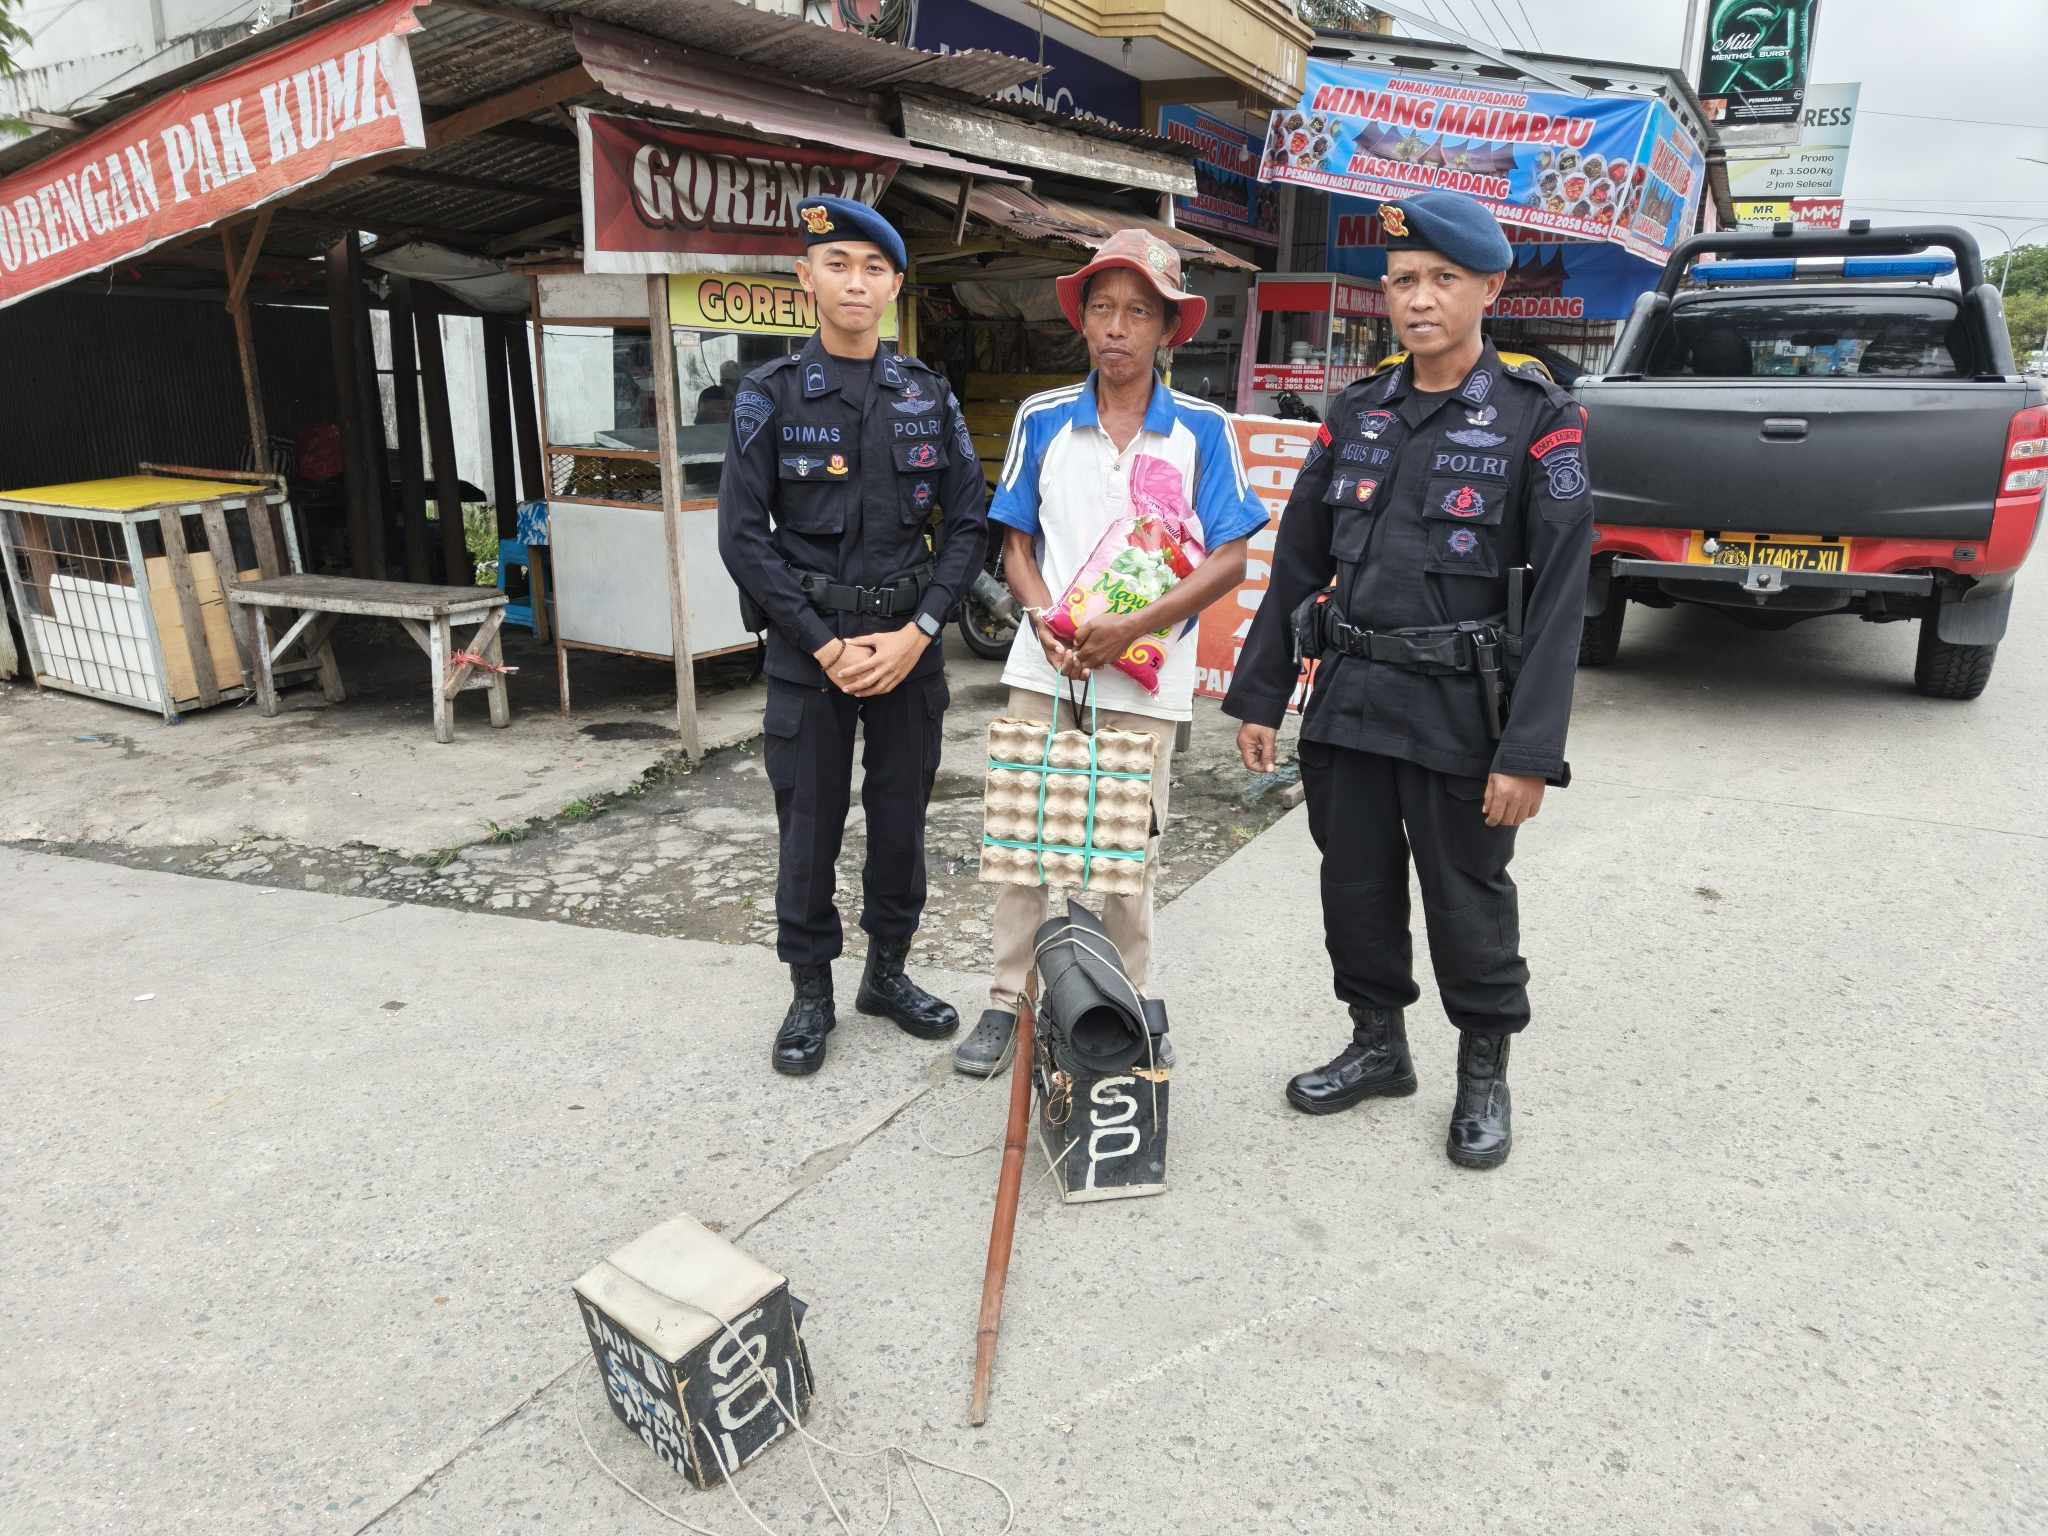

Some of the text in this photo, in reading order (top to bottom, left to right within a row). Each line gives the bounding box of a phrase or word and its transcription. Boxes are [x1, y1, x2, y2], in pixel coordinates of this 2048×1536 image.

[1712, 33, 1760, 51] Mild
[1711, 50, 1791, 61] MENTHOL BURST
[1388, 79, 1528, 109] RUMAH MAKAN PADANG
[1312, 84, 1597, 149] MINANG MAIMBAU
[1803, 107, 1852, 127] RESS
[1800, 154, 1834, 163] Promo
[0, 139, 160, 273] ORENGAN
[161, 99, 256, 203] PAK
[1328, 175, 1350, 188] NASI
[1348, 155, 1511, 199] MASAKAN PADANG
[1766, 181, 1773, 189] 2
[1753, 205, 1774, 214] MR
[1530, 211, 1554, 226] 0812
[1555, 215, 1581, 230] 2058
[698, 279, 821, 328] GOREN
[1497, 297, 1583, 318] PADANG
[783, 426, 841, 443] DIMAS
[895, 419, 941, 438] POLRI
[1341, 443, 1390, 465] AGUS WP
[1433, 453, 1509, 476] POLRI
